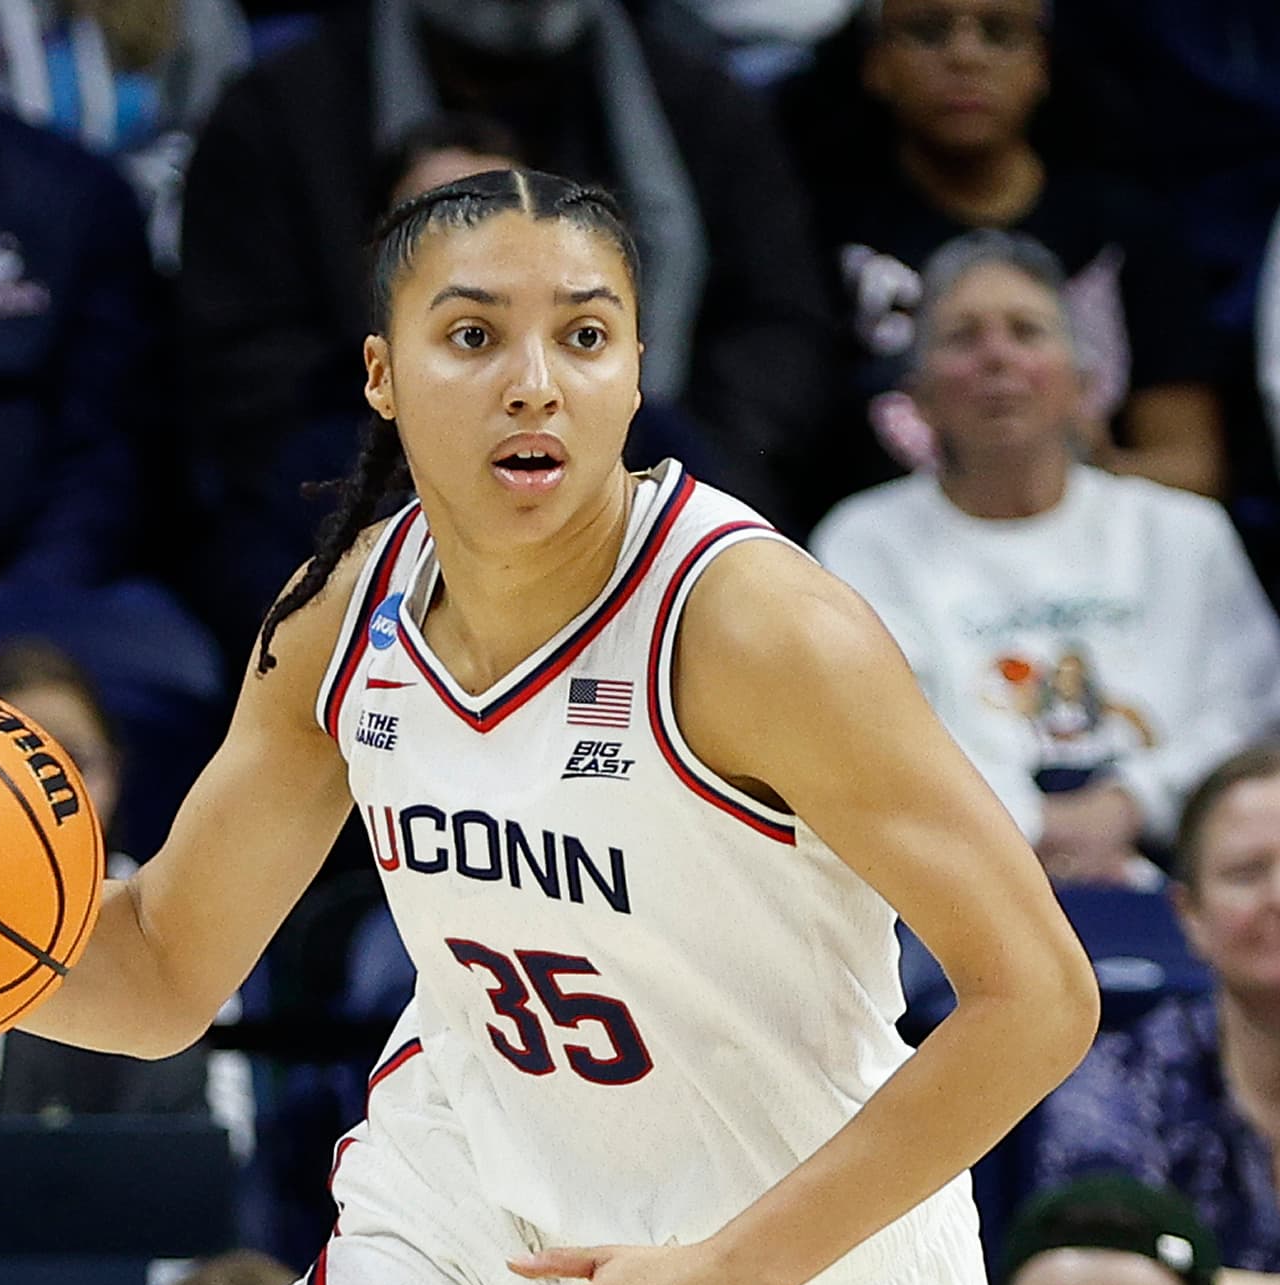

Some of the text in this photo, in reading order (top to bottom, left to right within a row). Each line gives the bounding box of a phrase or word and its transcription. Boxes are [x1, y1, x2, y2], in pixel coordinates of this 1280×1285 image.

[368, 711, 399, 733] THE
[573, 740, 622, 757] BIG
[565, 756, 636, 774] EAST
[367, 803, 632, 915] UCONN
[444, 937, 655, 1086] 35
